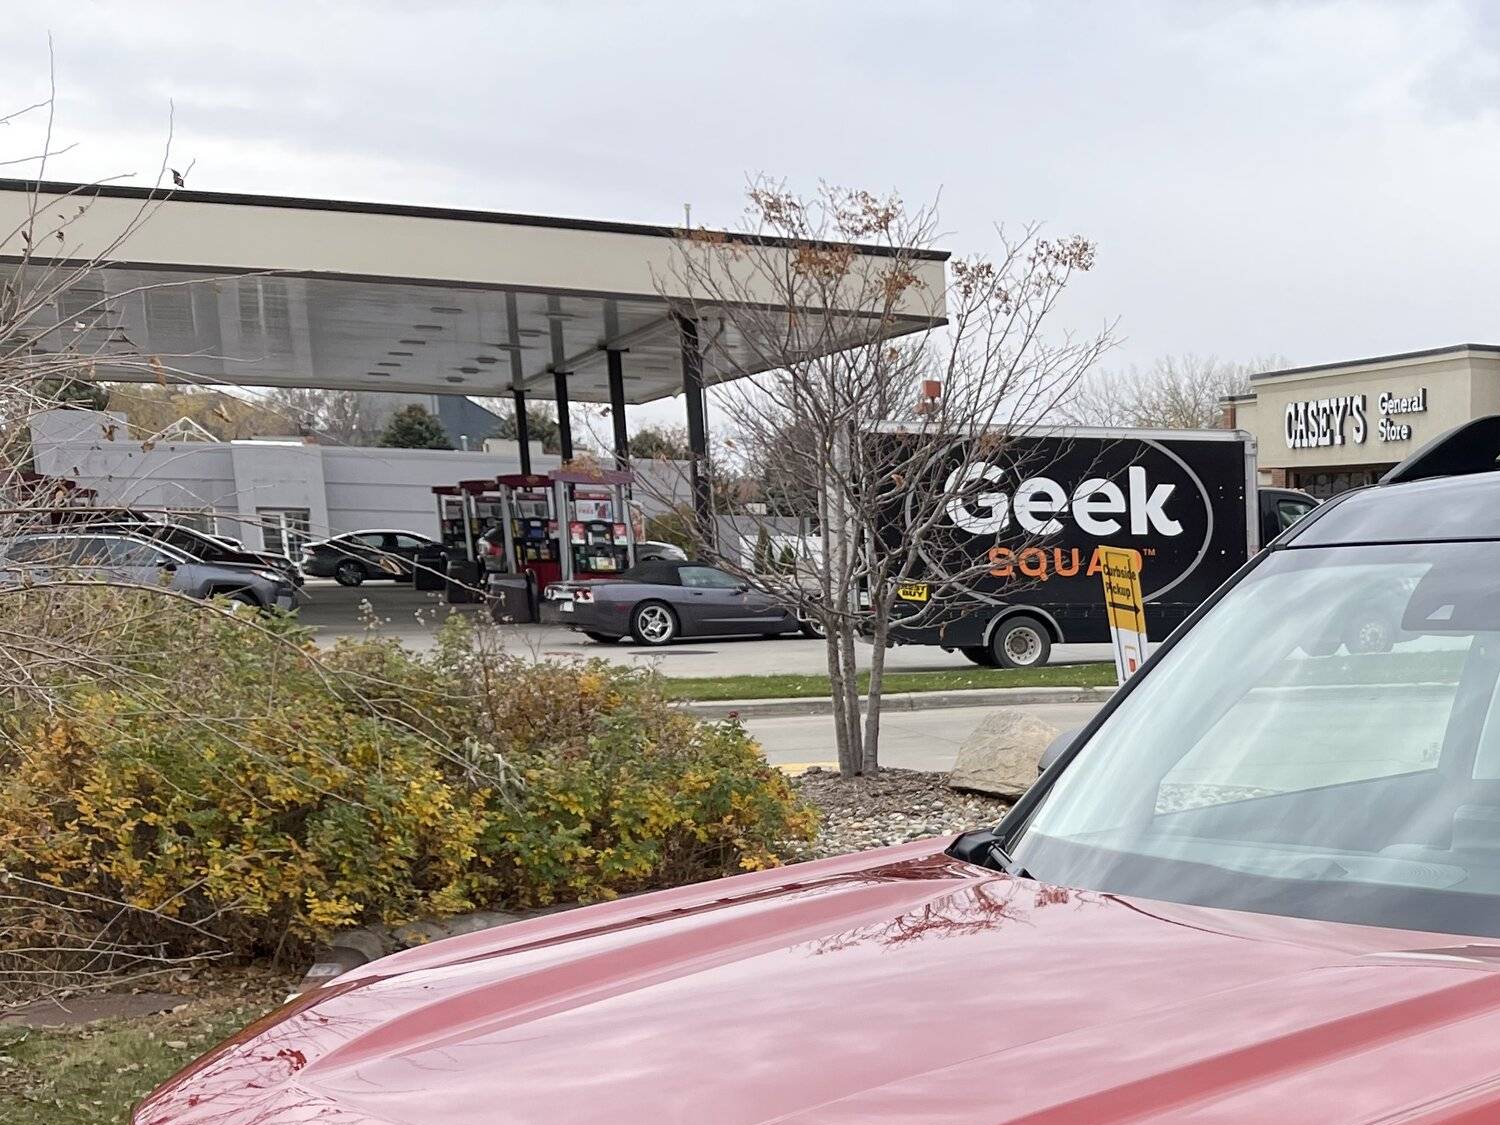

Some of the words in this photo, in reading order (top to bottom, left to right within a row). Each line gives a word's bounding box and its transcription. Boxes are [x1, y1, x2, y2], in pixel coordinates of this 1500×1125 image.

[1379, 387, 1427, 415] General
[1285, 394, 1366, 449] CASEY'S
[1378, 418, 1411, 442] Store
[944, 461, 1184, 537] Geek
[988, 546, 1143, 582] SQUA
[1103, 564, 1136, 580] Curbside
[902, 589, 923, 598] BUY
[1106, 581, 1131, 600] Pickup
